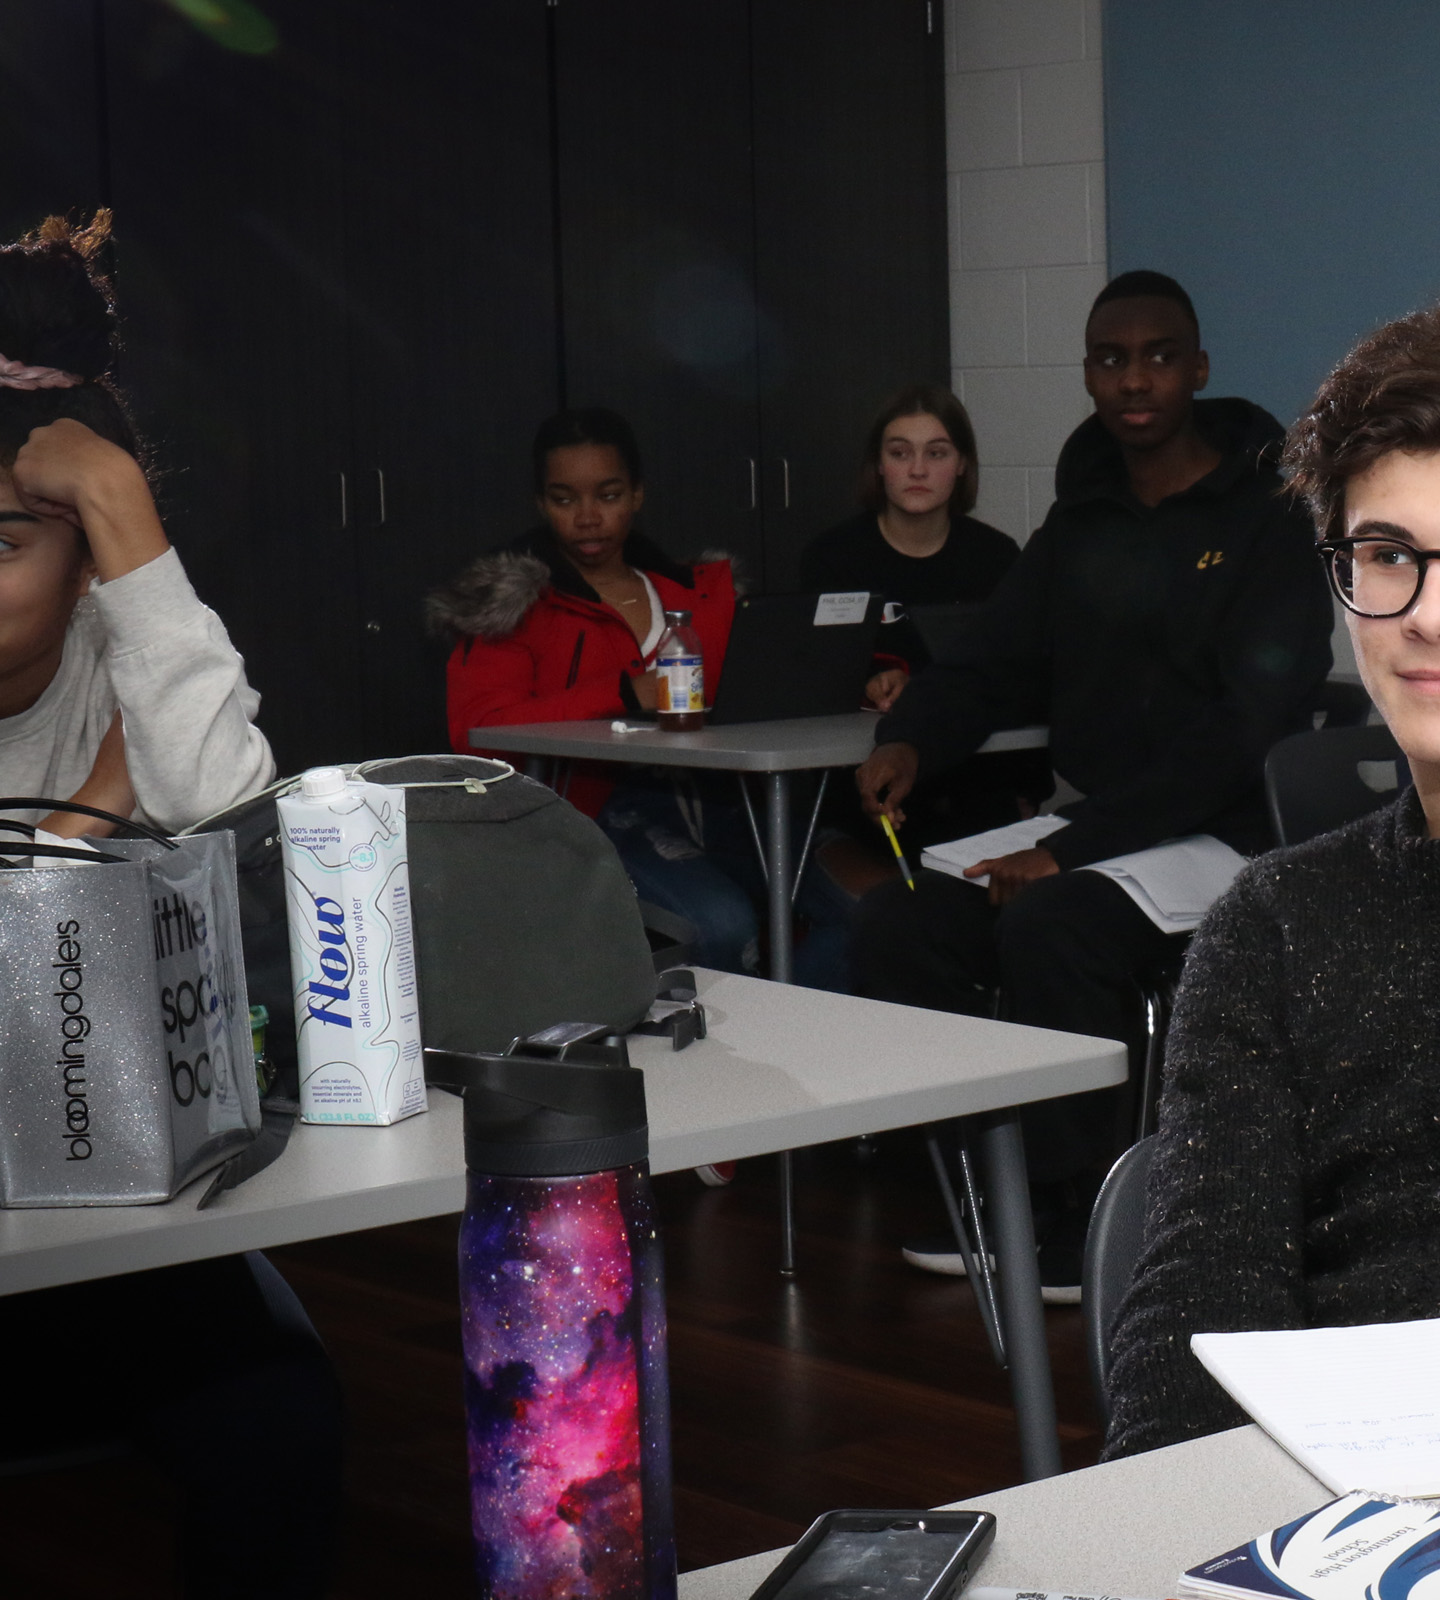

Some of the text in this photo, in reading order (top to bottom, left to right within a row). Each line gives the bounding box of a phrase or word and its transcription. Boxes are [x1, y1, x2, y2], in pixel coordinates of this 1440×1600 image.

[290, 835, 341, 844] alkaline spring
[309, 827, 341, 835] naturally
[308, 896, 352, 1028] flow
[352, 897, 371, 1028] alkaline spring water
[311, 1113, 318, 1121] L
[345, 1113, 355, 1121] FL
[1310, 1526, 1417, 1579] Farmington High
[1323, 1538, 1370, 1561] School
